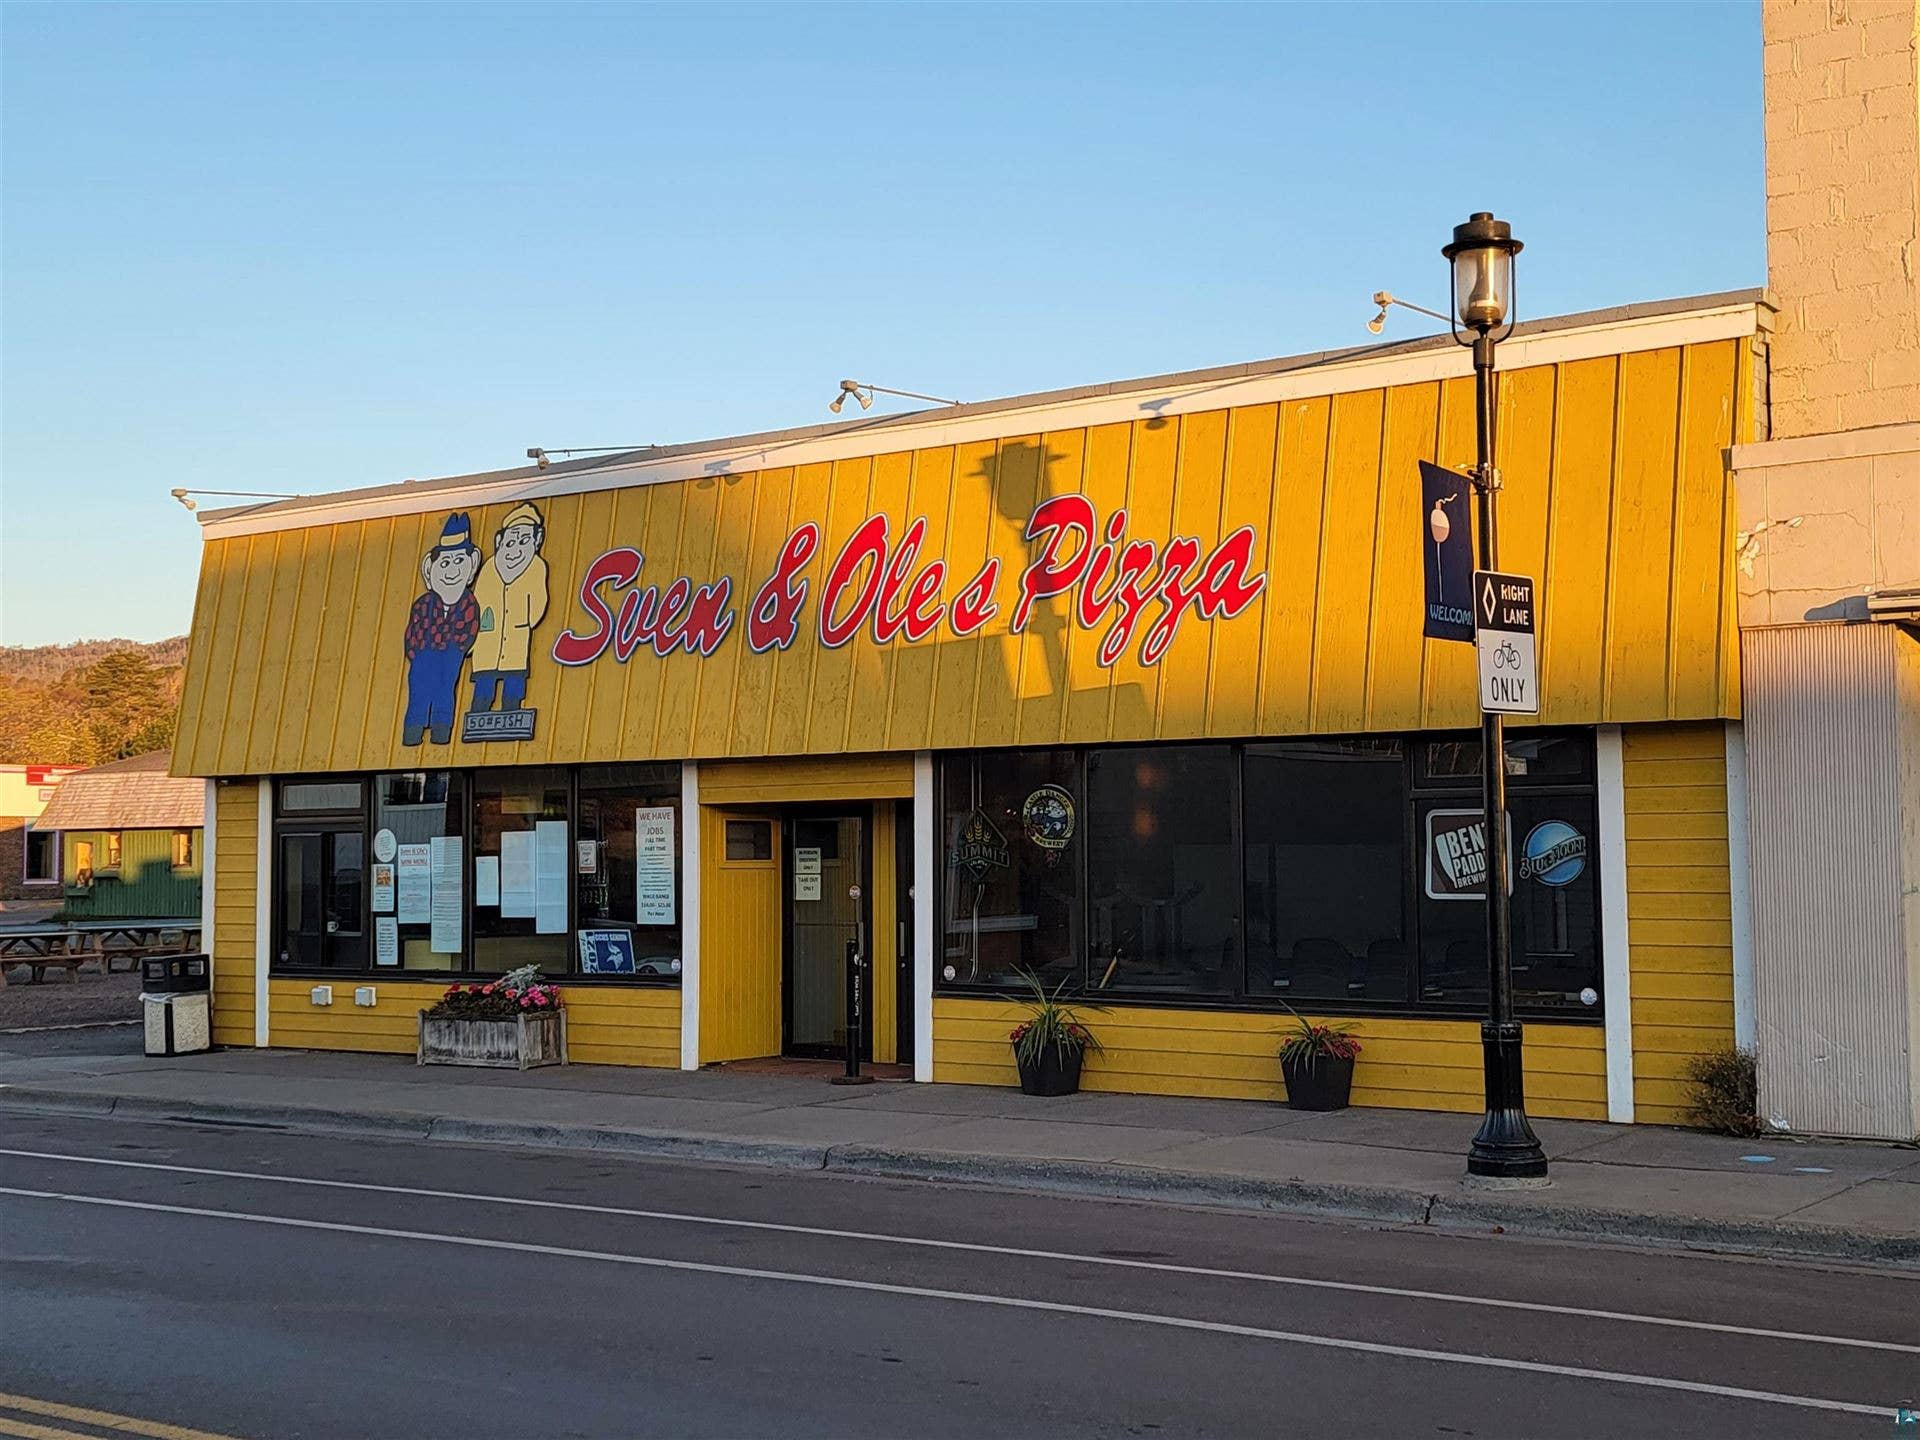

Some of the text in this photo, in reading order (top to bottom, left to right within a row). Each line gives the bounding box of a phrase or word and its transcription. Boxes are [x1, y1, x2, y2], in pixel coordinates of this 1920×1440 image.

[552, 547, 735, 666] Sven
[749, 520, 820, 654] &
[1009, 493, 1269, 668] Pizza
[1500, 583, 1531, 603] RIGHT
[1429, 602, 1474, 626] WELCOM
[1502, 607, 1530, 626] LANE
[1490, 676, 1527, 703] ONLY
[639, 811, 672, 821] WE HAVE
[647, 826, 665, 835] JOBS
[1445, 822, 1486, 858] BEN
[951, 846, 1007, 864] SUMMIT
[1452, 851, 1487, 877] PADD
[1457, 871, 1487, 888] BREWIN
